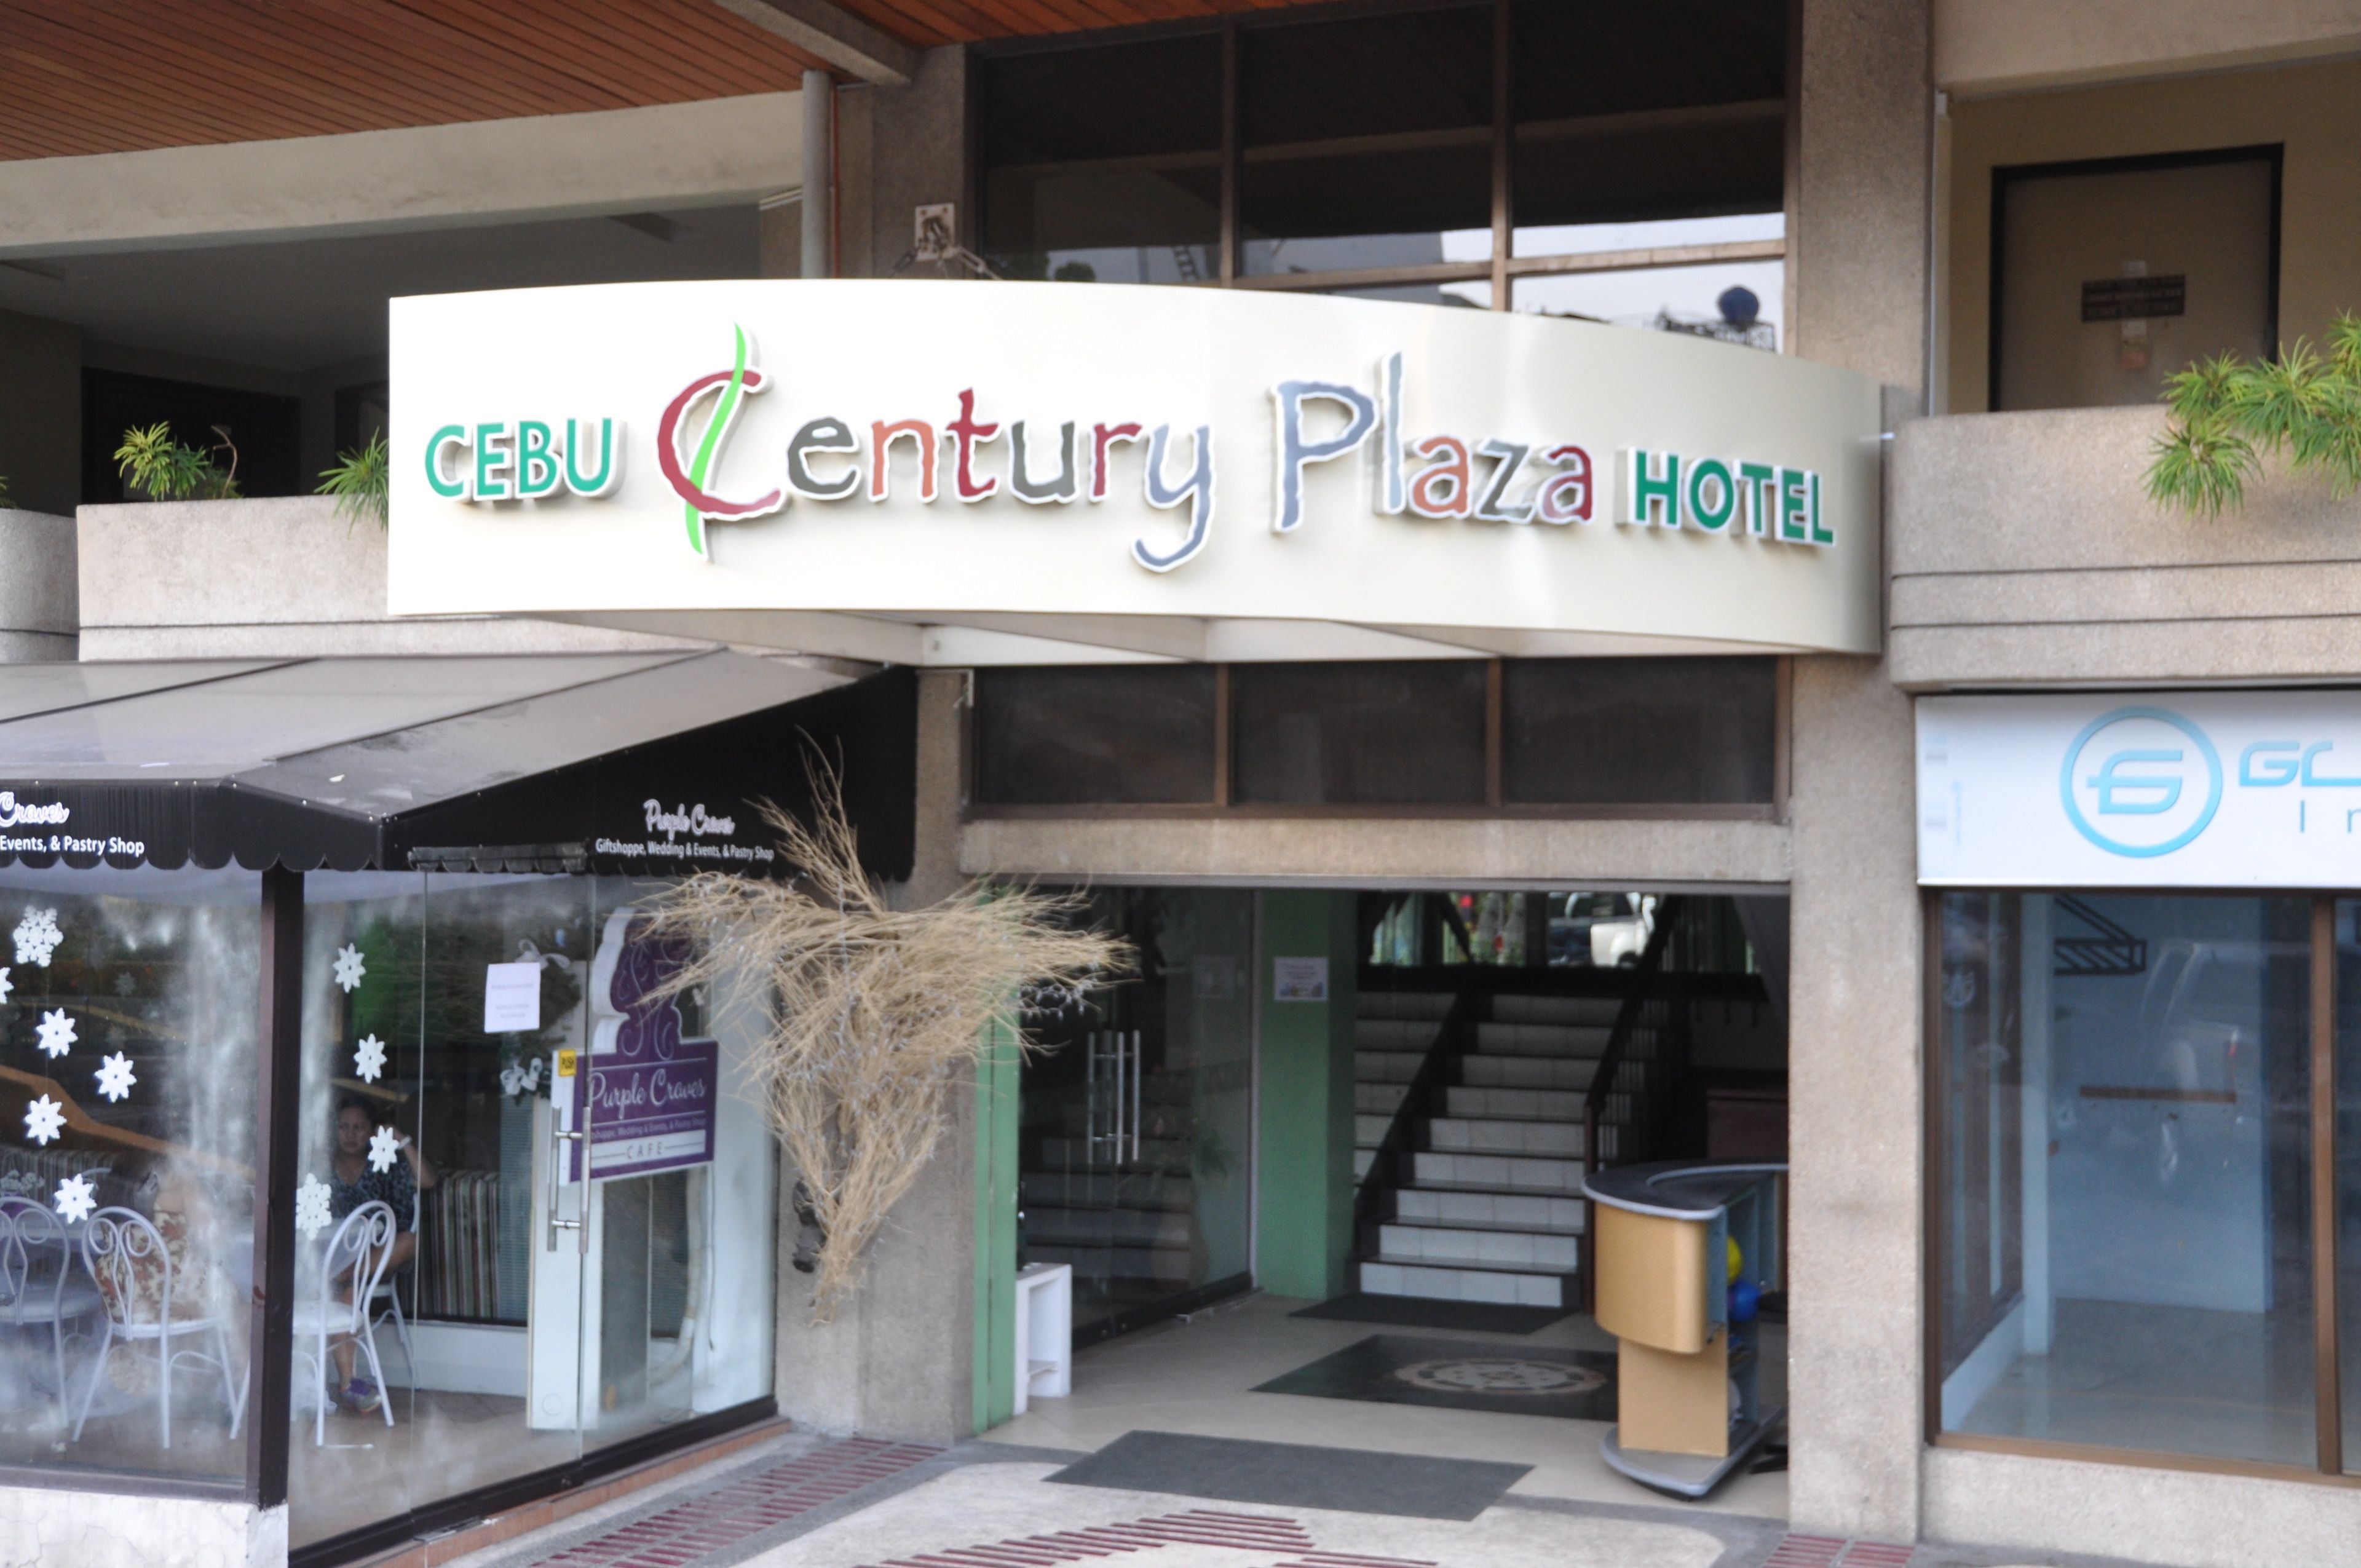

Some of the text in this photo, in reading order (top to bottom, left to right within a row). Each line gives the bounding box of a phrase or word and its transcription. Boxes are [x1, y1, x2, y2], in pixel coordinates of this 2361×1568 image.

[424, 322, 1836, 572] CEBU Century Plaza HOTEL
[643, 799, 690, 841] Purple
[0, 835, 144, 857] Events, & Pastry Shop
[647, 841, 684, 860] Wedding
[686, 842, 692, 856] &
[722, 844, 730, 858] &
[730, 845, 754, 862] Pastry
[755, 846, 775, 862] Shop
[591, 1069, 705, 1119] Purple Craves
[627, 1142, 663, 1159] CAFE
